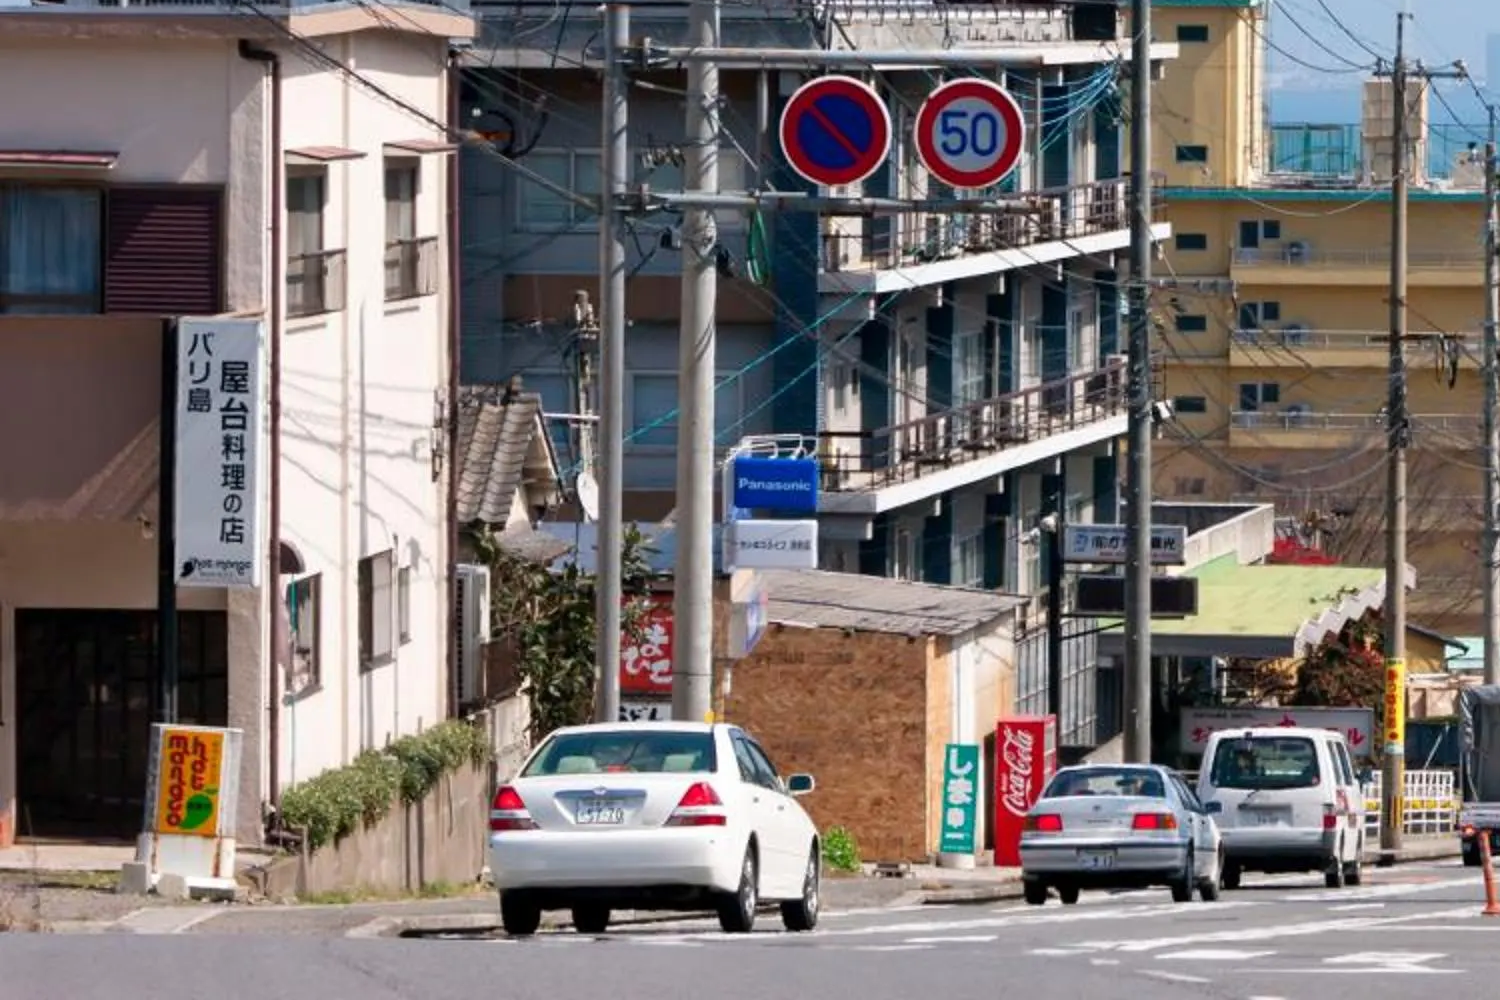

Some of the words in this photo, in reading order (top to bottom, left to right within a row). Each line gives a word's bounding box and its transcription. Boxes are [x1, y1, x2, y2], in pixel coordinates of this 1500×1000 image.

[940, 111, 999, 157] 50
[188, 333, 214, 413] バリ島
[219, 360, 249, 544] 屋台料理の店
[739, 477, 812, 492] Panasonic
[166, 735, 190, 827] mango
[191, 735, 209, 791] hot
[1001, 727, 1034, 817] Coca-Cola
